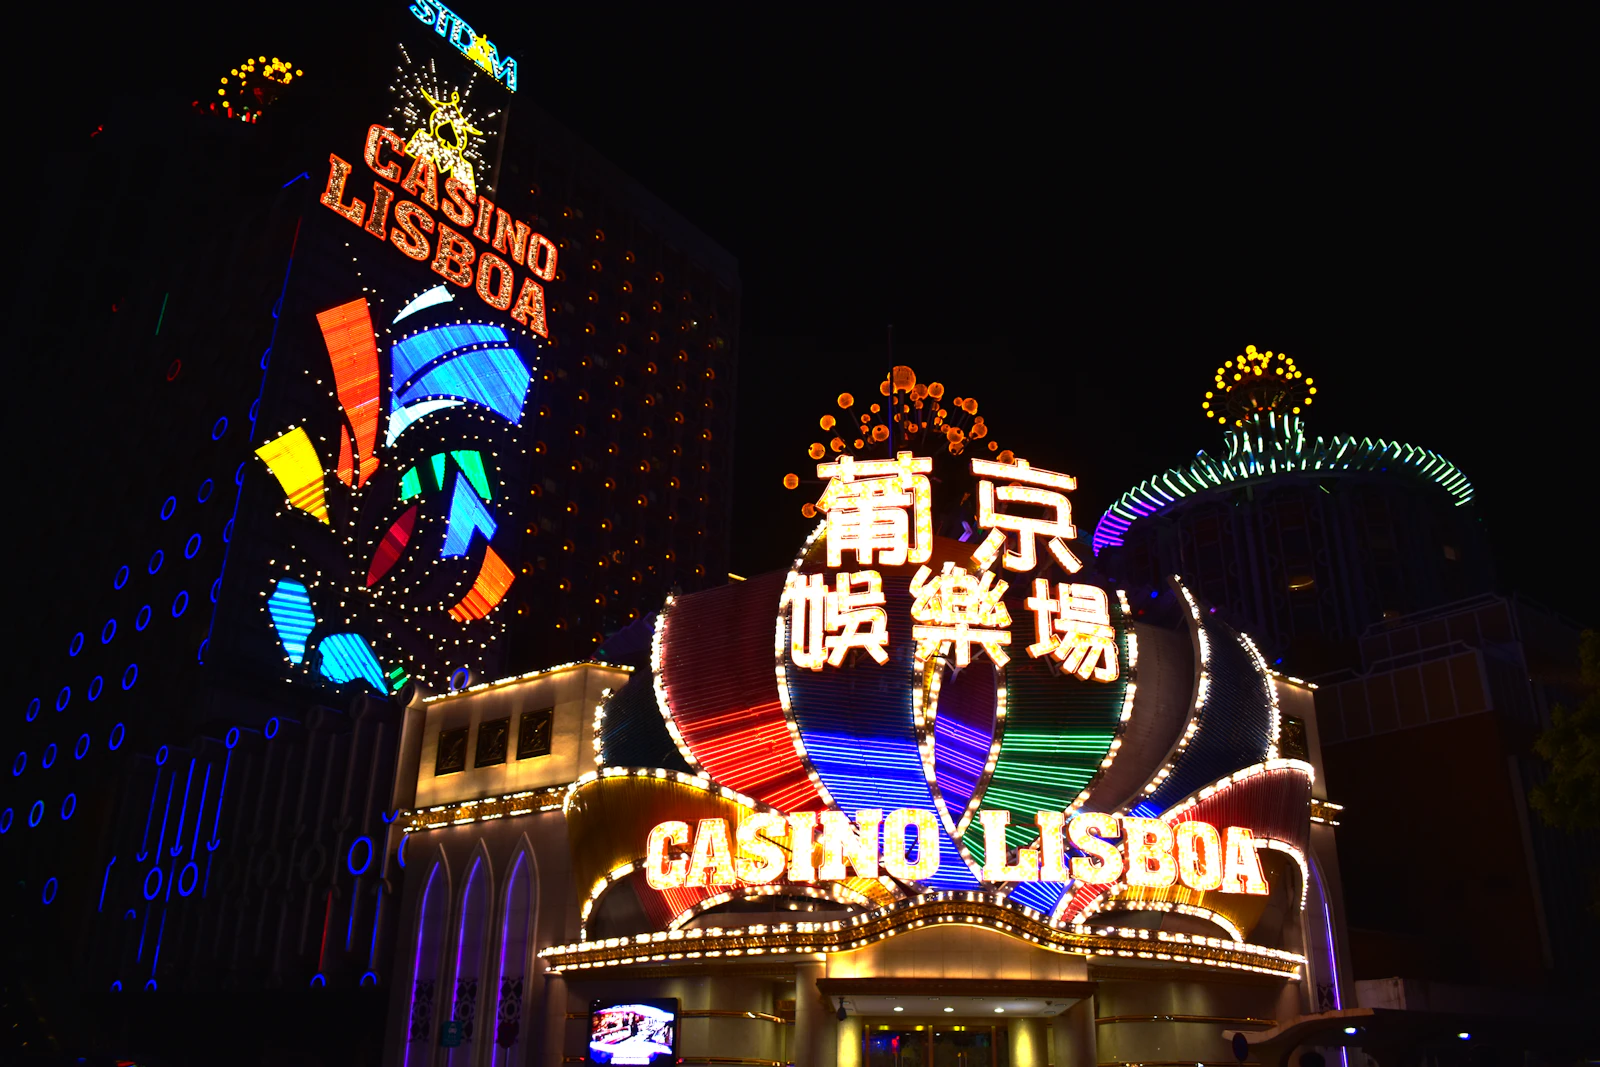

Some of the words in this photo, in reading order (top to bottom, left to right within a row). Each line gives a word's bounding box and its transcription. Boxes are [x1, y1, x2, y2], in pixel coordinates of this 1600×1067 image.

[320, 153, 549, 339] LISBOA
[364, 124, 558, 282] CASINO
[815, 451, 1083, 575] 葡京
[645, 808, 940, 890] CASINO
[979, 809, 1269, 896] LISBOA
